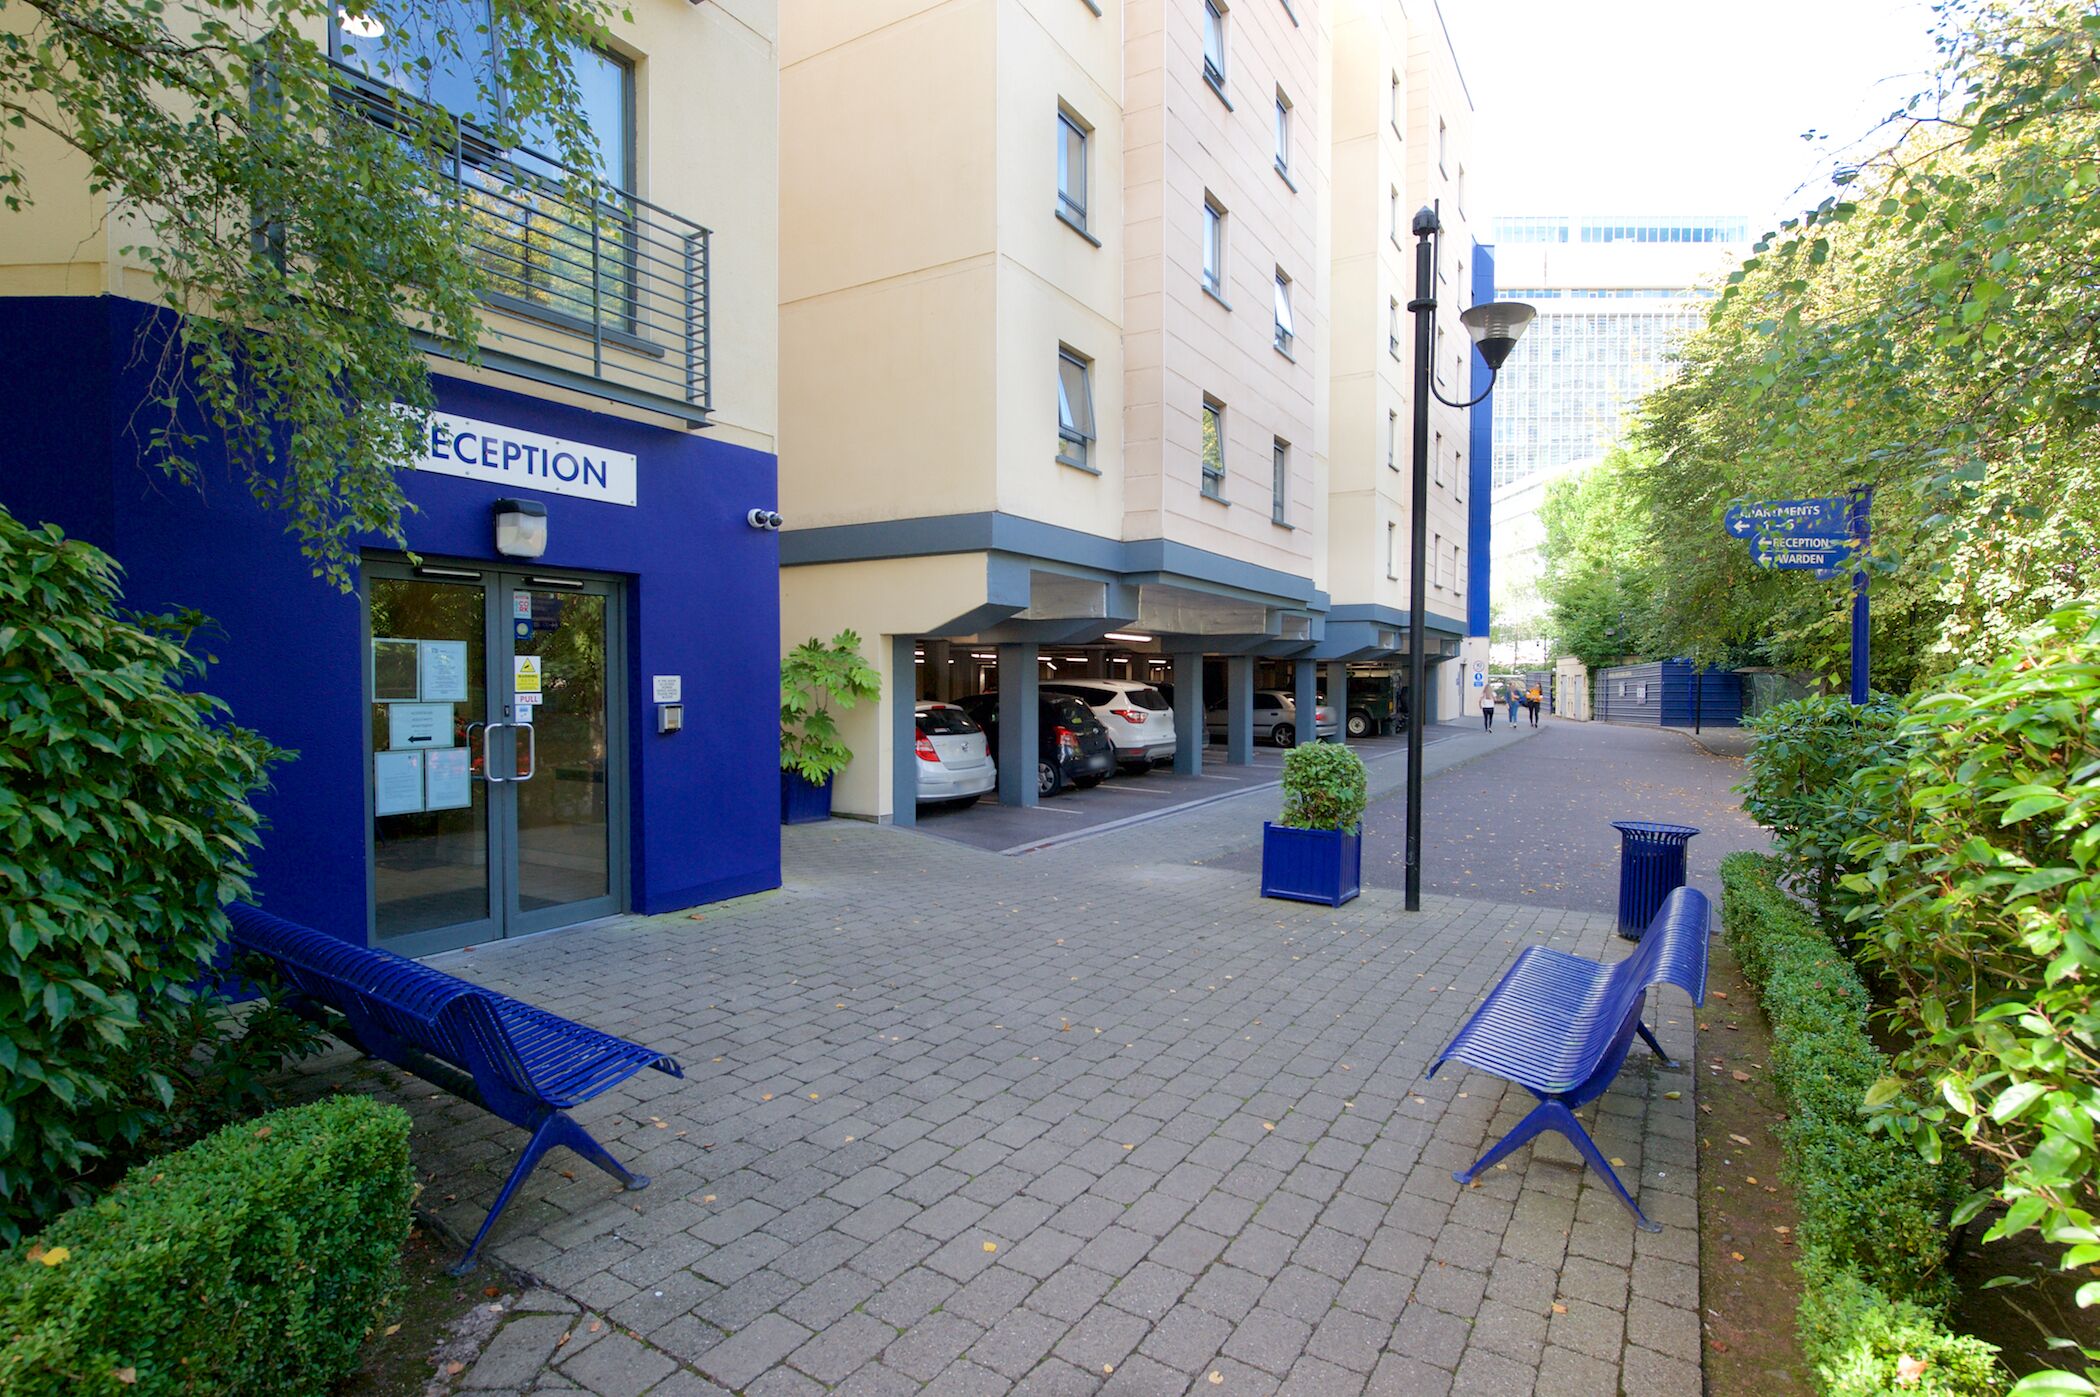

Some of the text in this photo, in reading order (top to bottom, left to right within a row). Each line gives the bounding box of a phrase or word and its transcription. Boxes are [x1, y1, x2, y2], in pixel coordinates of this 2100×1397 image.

[412, 424, 607, 489] ECEPTION
[1740, 505, 1820, 518] ARMENTS
[1778, 554, 1824, 564] WARDEN
[520, 695, 538, 703] PULL
